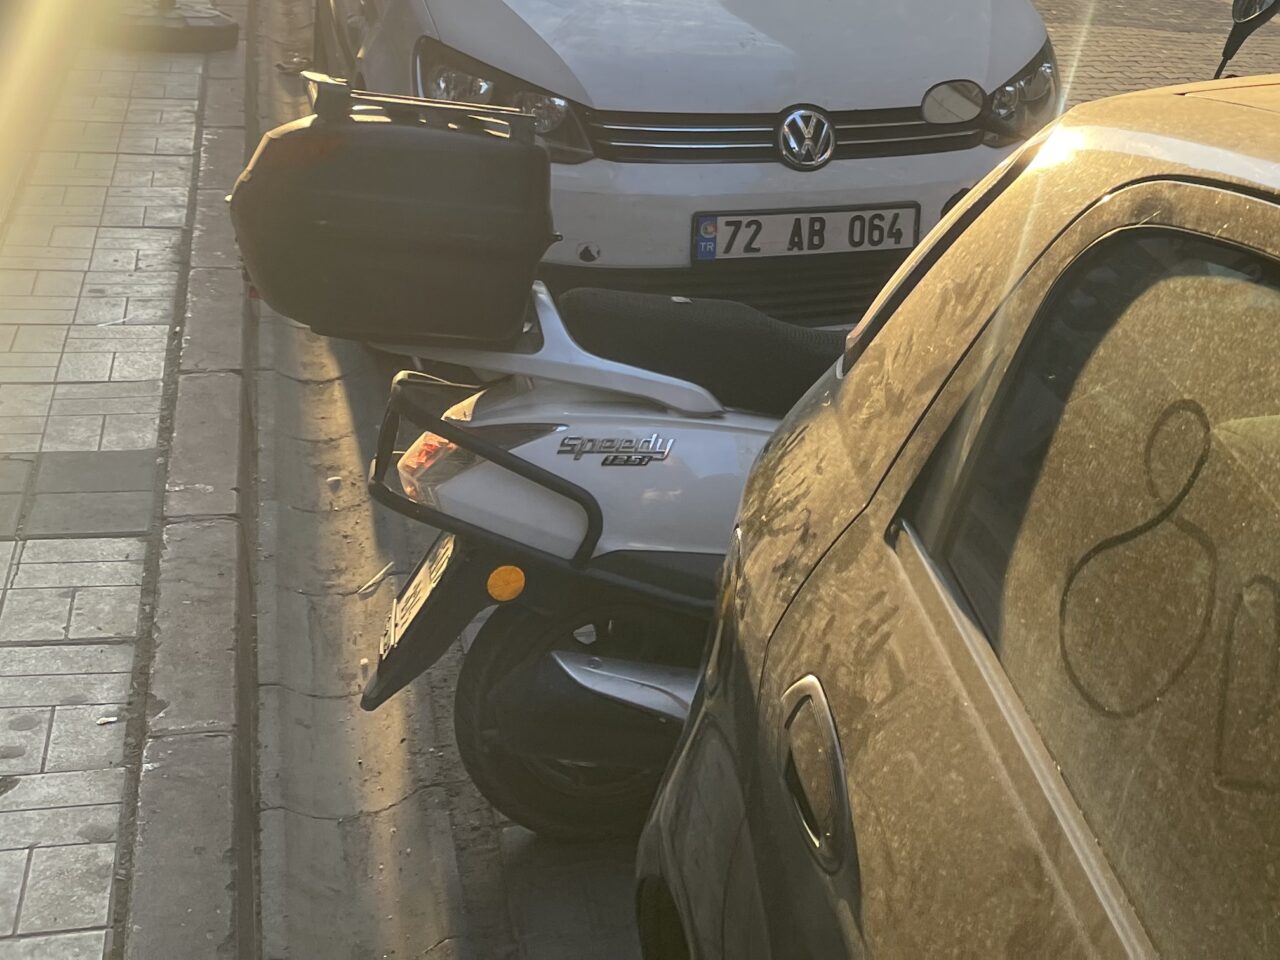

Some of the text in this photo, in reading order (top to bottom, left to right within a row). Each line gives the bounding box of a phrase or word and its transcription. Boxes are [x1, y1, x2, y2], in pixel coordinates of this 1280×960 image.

[699, 212, 903, 255] TR 72 AB 064
